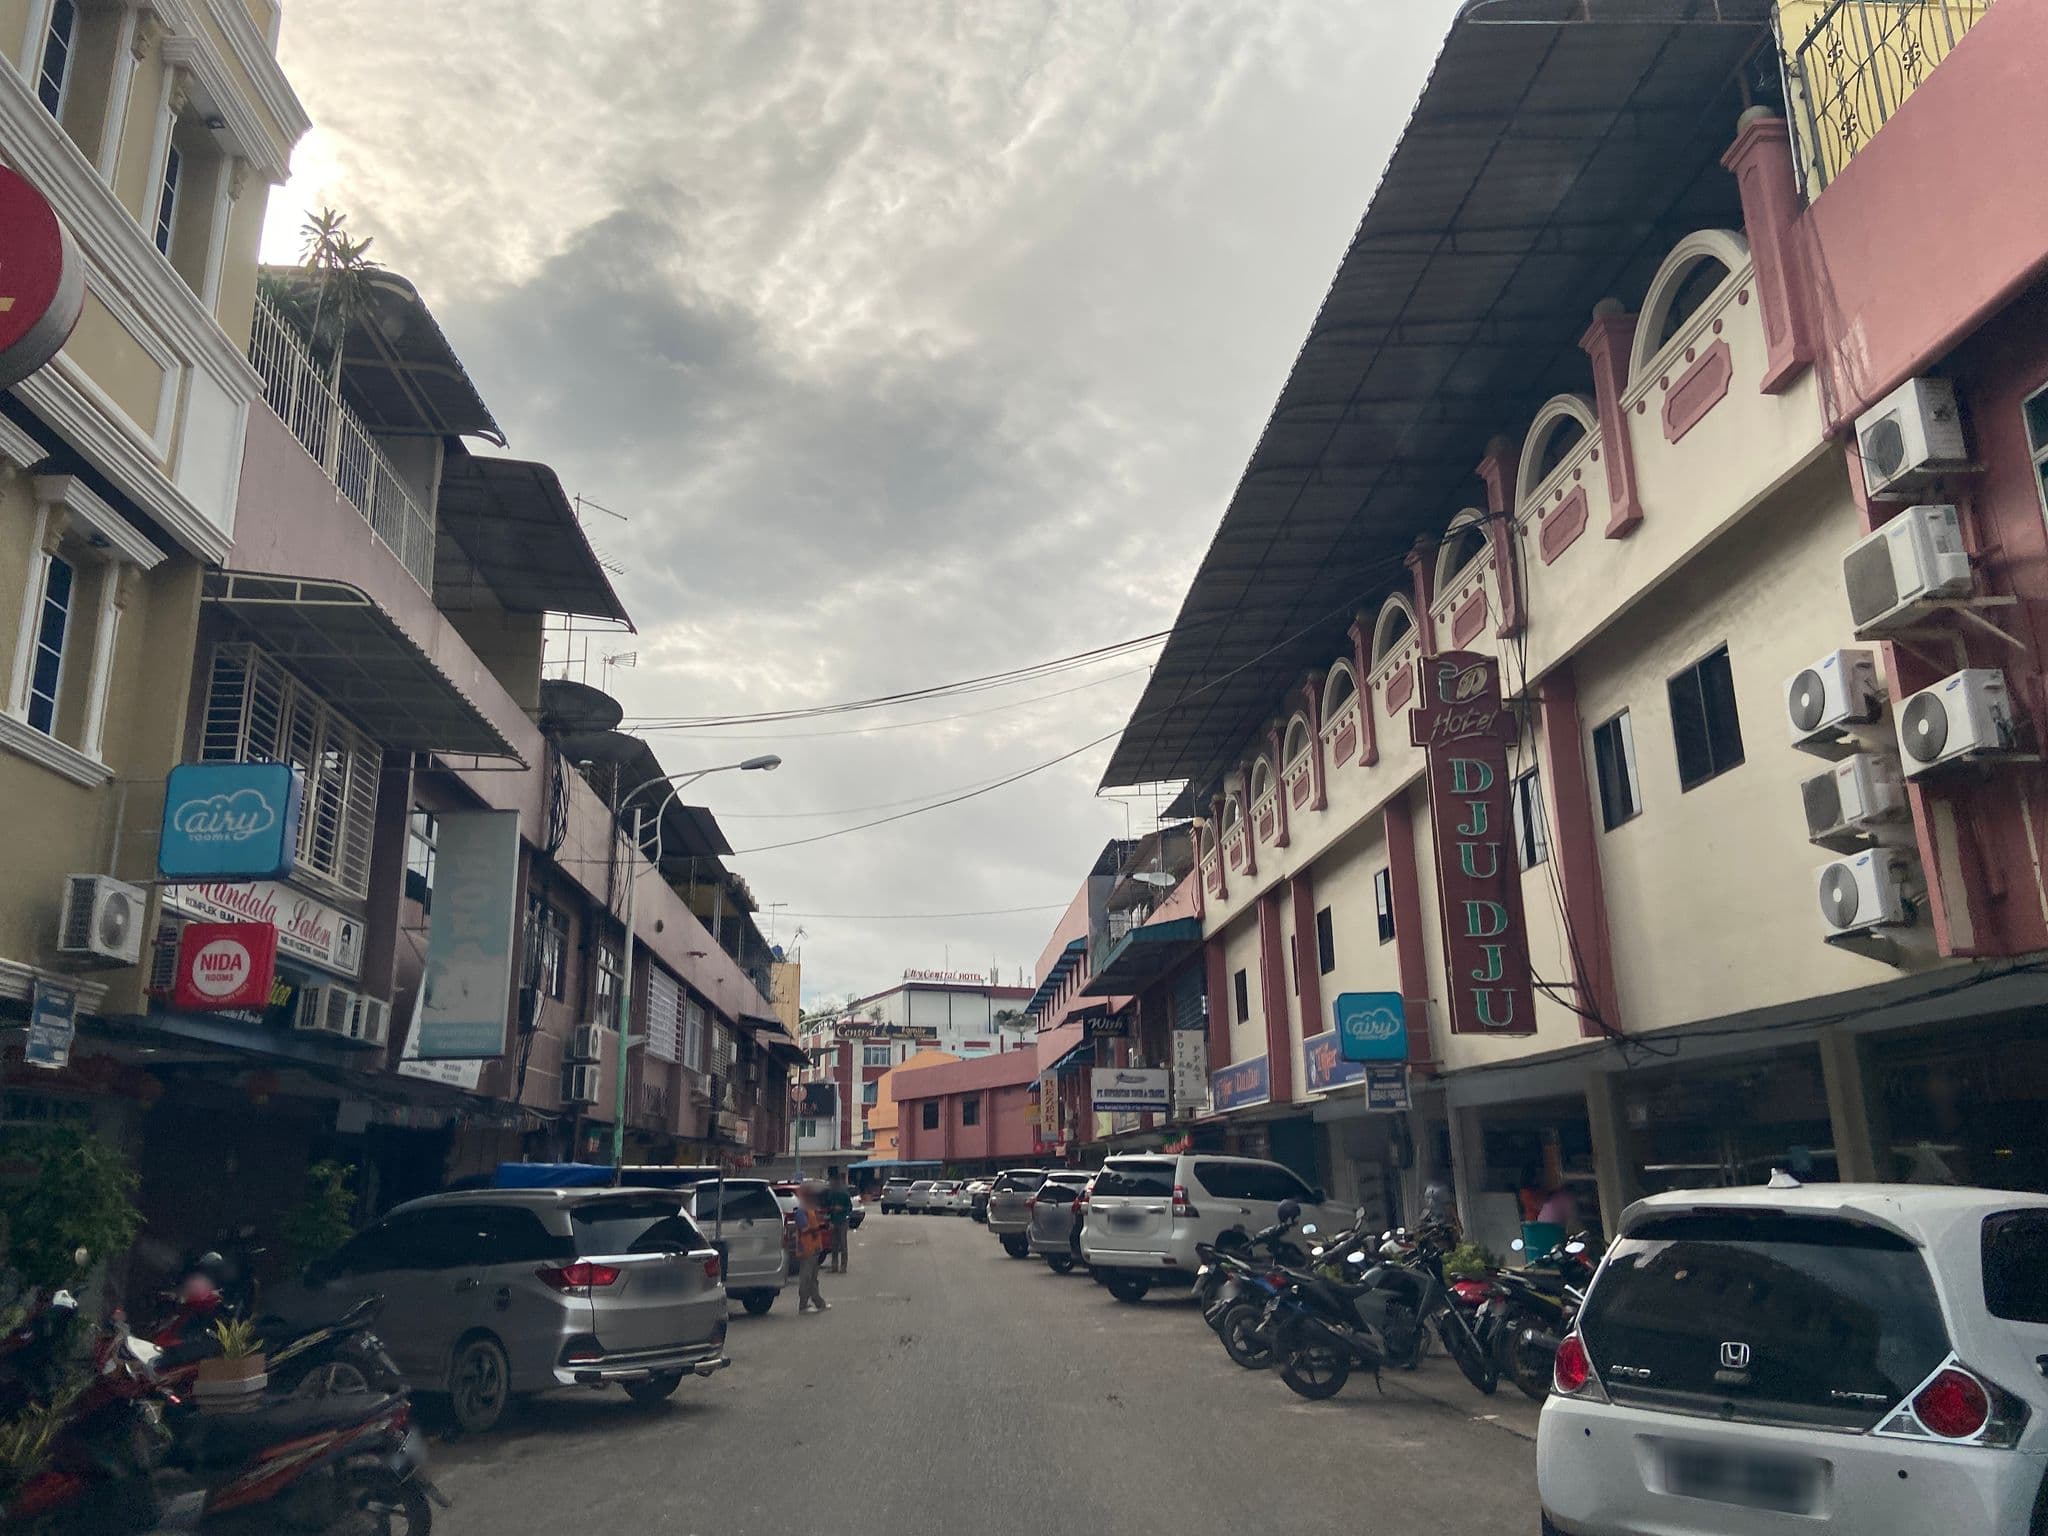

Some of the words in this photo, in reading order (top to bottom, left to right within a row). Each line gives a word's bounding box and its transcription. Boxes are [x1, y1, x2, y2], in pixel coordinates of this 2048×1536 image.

[1430, 707, 1499, 741] Hotel
[184, 803, 259, 841] airy
[200, 953, 242, 971] NIDA
[205, 973, 234, 982] ROOMS
[959, 972, 982, 981] HOTEL
[1352, 1014, 1392, 1041] airy
